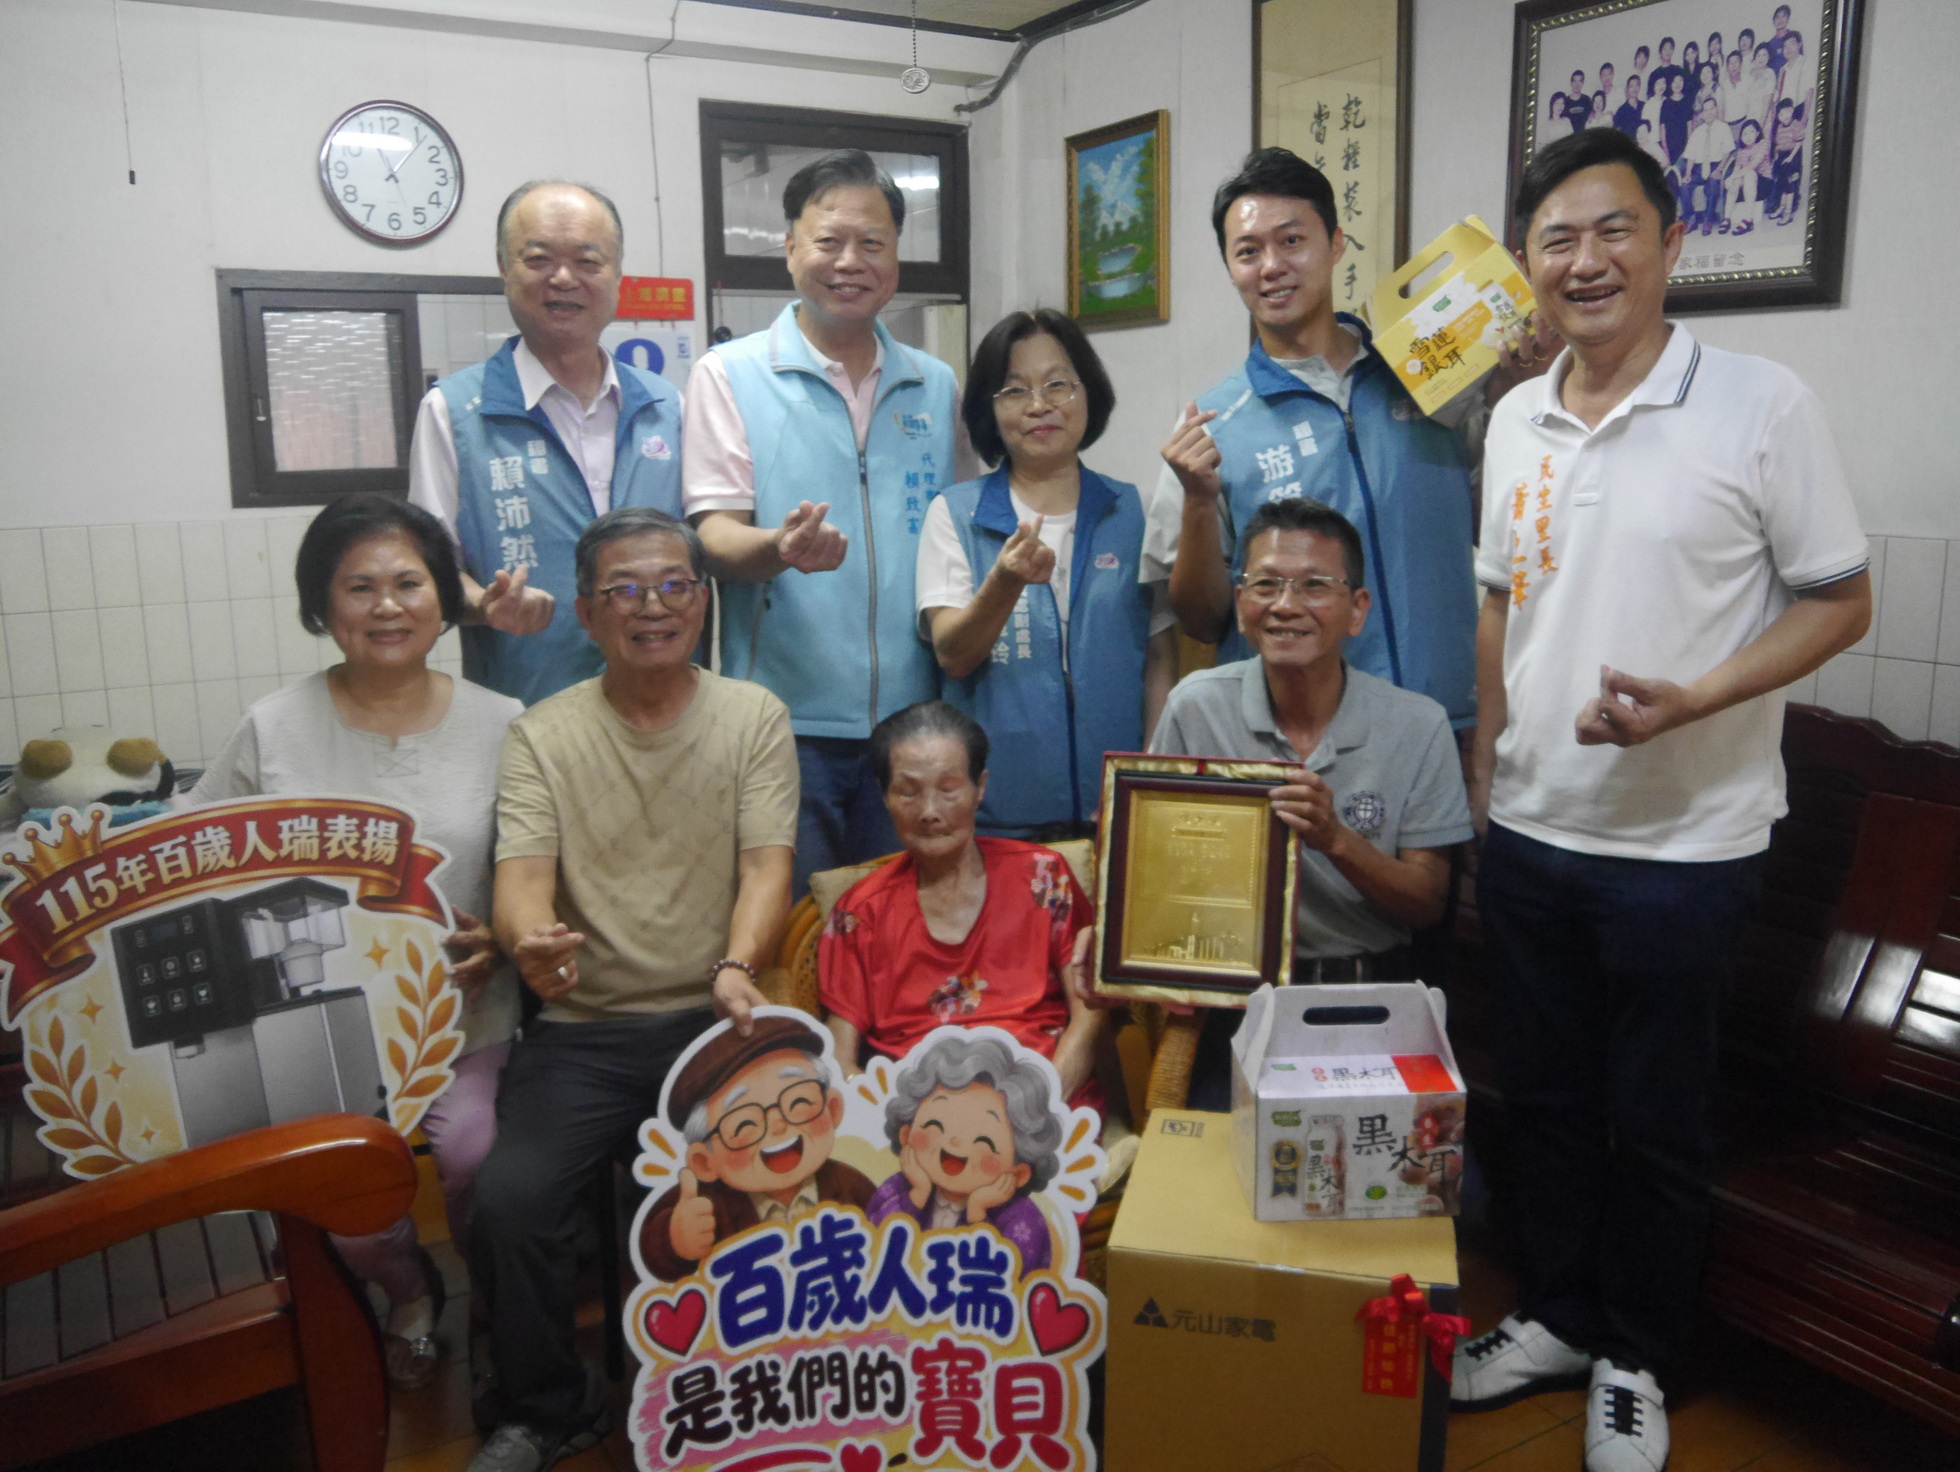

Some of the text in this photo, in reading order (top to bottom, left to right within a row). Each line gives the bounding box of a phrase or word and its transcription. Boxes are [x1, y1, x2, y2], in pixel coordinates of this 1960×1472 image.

[378, 116, 401, 136] 12
[413, 125, 421, 143] 1
[427, 145, 441, 164] 2
[333, 160, 349, 180] 9
[434, 168, 449, 187] 3
[342, 184, 358, 204] 8
[427, 190, 442, 209] 4
[361, 203, 376, 222] 7
[387, 212, 402, 231] 6
[412, 206, 427, 225] 5
[1410, 326, 1456, 360] 雪蓮
[489, 455, 539, 570] 賴沛然
[34, 813, 401, 936] 115年百歲人瑞表揚
[1352, 1113, 1457, 1185] 黑木耳
[709, 1212, 1015, 1349] 百歲人瑞
[1171, 1308, 1277, 1343] 元山家電
[664, 1337, 1071, 1471] 是我們的寶貝
